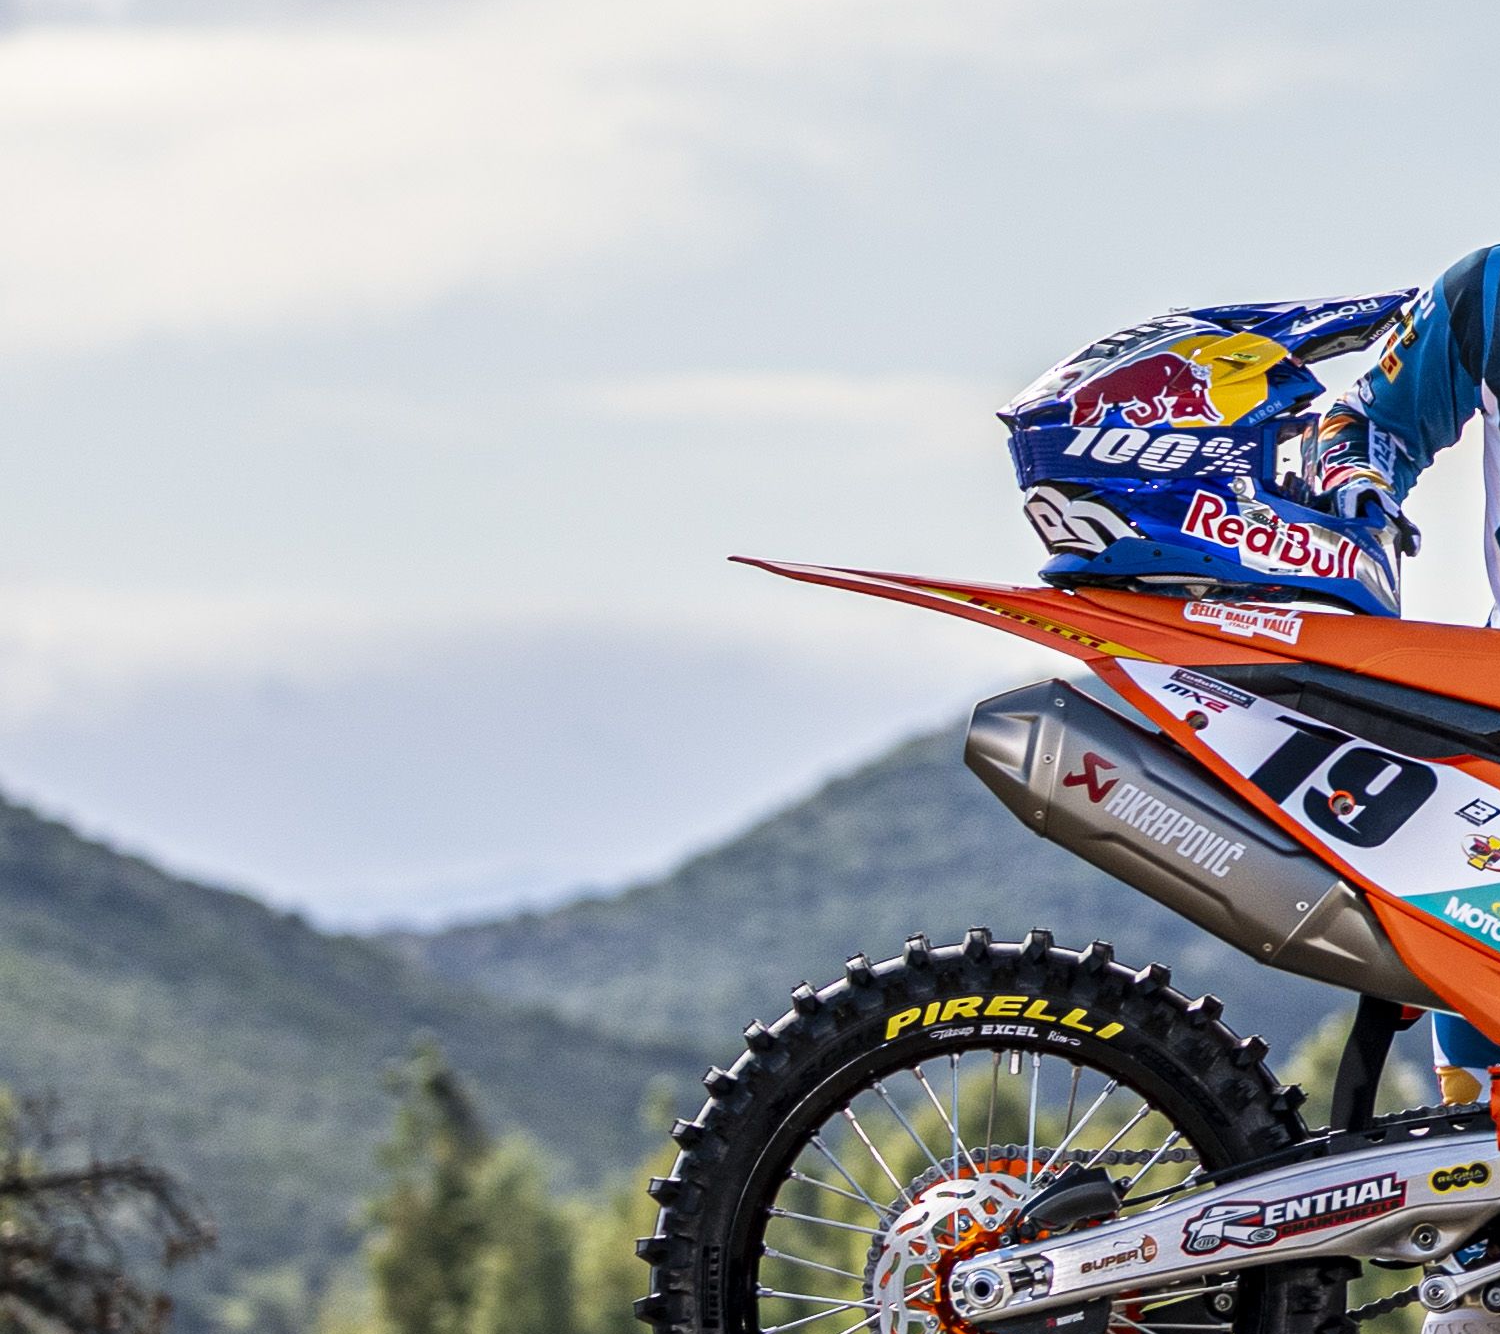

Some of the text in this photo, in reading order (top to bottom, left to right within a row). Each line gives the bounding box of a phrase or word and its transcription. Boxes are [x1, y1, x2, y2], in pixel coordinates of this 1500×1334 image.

[1248, 400, 1282, 424] AIROH
[1063, 427, 1258, 475] 100%
[1182, 488, 1281, 557] Red
[1278, 524, 1362, 580] Bull
[1190, 603, 1222, 619] SELLE
[1263, 618, 1296, 636] VALLE
[1161, 683, 1230, 713] MX2
[1248, 715, 1438, 849] 19
[1105, 783, 1248, 879] AKRAPOVIČ
[886, 996, 1125, 1040] PIRELLI
[981, 1025, 1082, 1046] EXCEL Rim
[1437, 1167, 1483, 1185] REGINA
[1186, 1179, 1403, 1252] RENTHAL
[1279, 1203, 1401, 1236] CHAINWHEELS
[1081, 1252, 1138, 1274] SUPER
